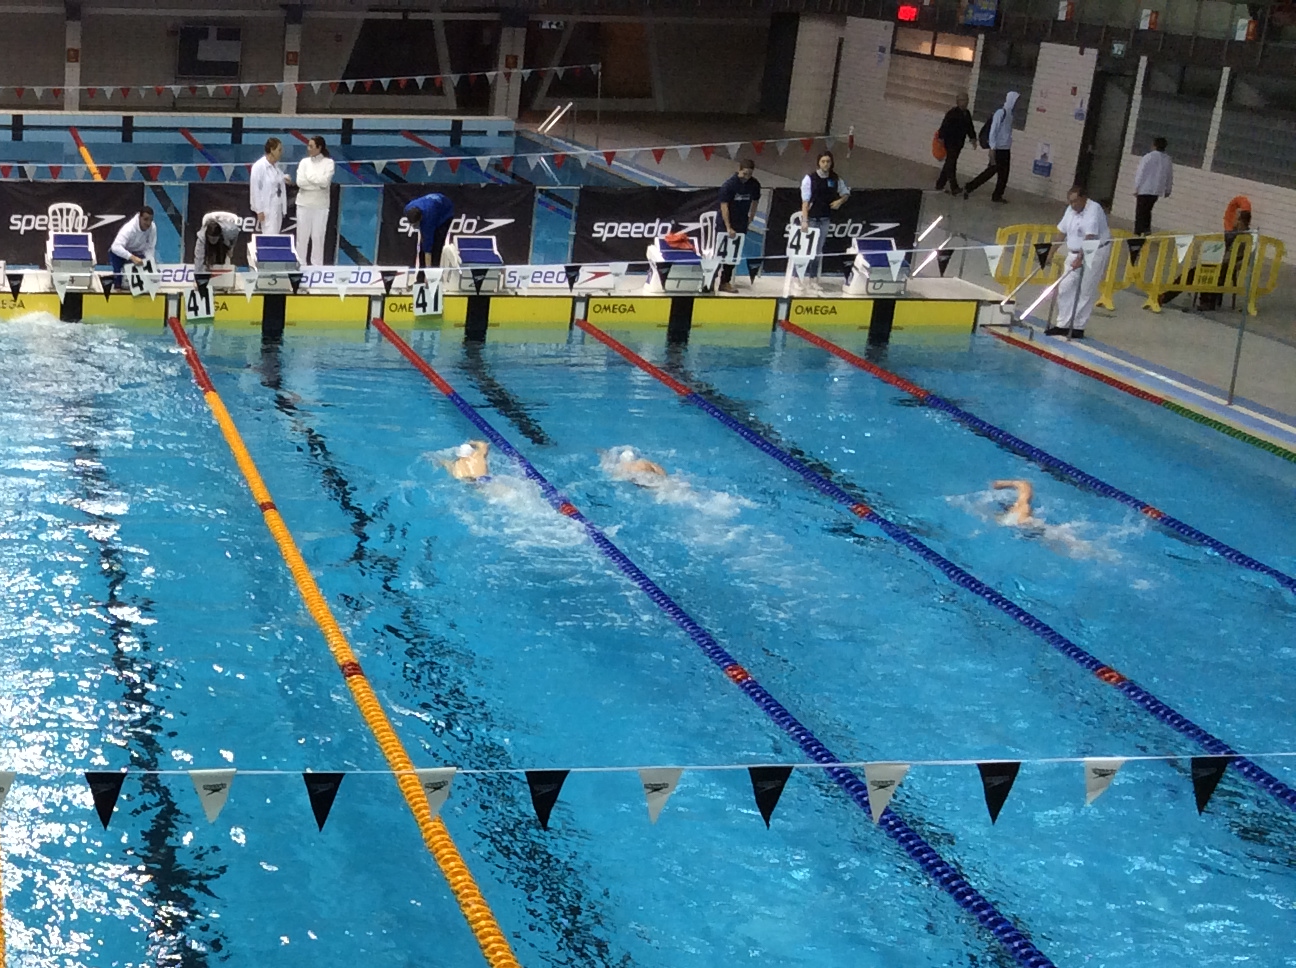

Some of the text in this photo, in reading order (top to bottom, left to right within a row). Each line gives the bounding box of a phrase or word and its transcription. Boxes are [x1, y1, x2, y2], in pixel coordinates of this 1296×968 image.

[592, 218, 672, 241] speedo
[790, 228, 816, 256] 41
[717, 234, 742, 262] 41
[131, 260, 154, 291] 41
[187, 288, 212, 316] 41
[415, 285, 439, 313] 41
[592, 303, 636, 314] OMEGA
[794, 305, 838, 316] OMEGA
